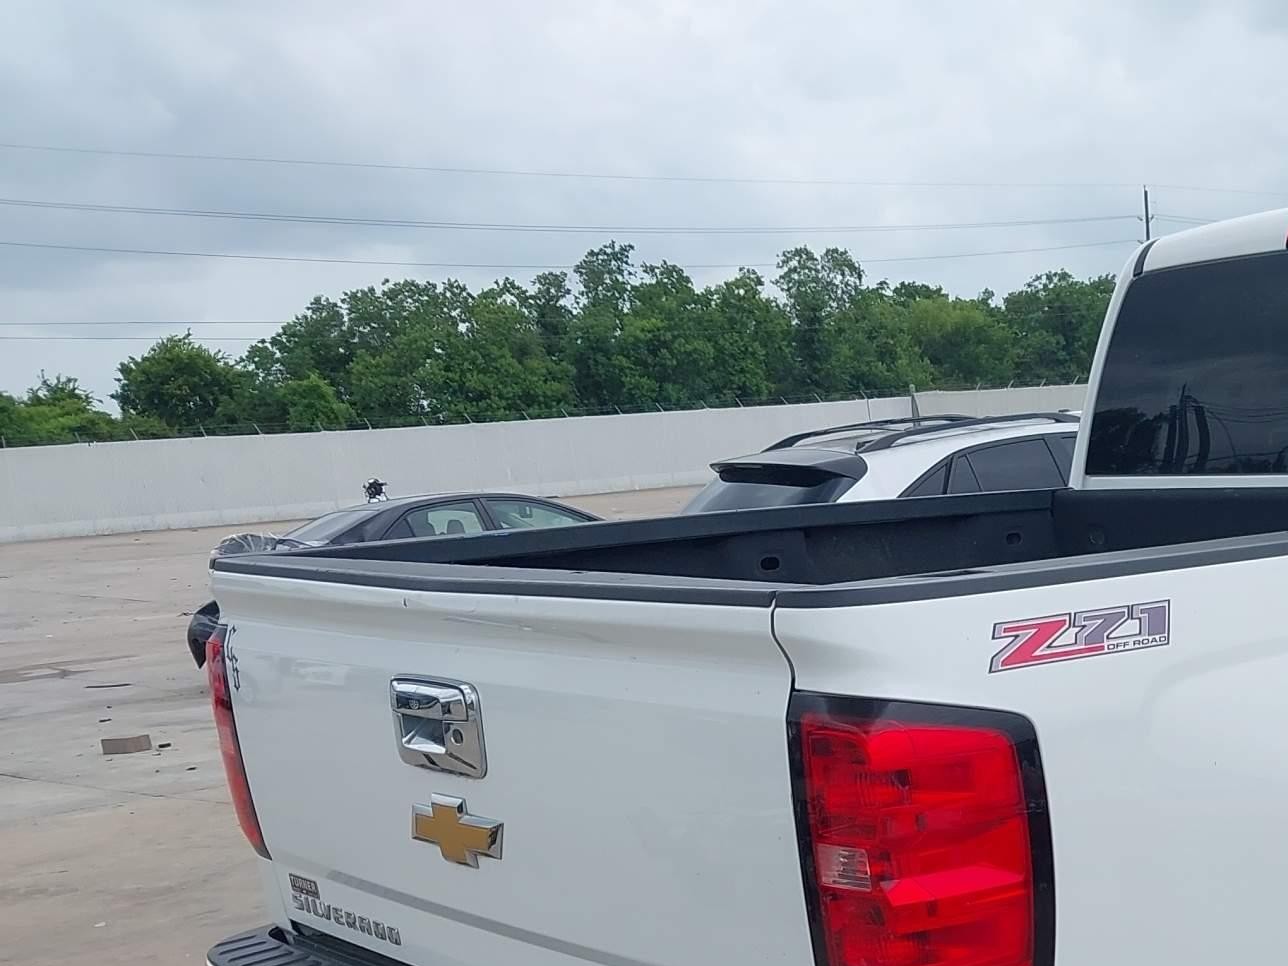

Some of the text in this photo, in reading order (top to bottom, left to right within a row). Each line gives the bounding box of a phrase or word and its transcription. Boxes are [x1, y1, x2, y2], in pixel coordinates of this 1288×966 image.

[988, 599, 1172, 674] Z71
[1106, 635, 1168, 651] OFF ROAD
[291, 893, 403, 947] SILVERADO
